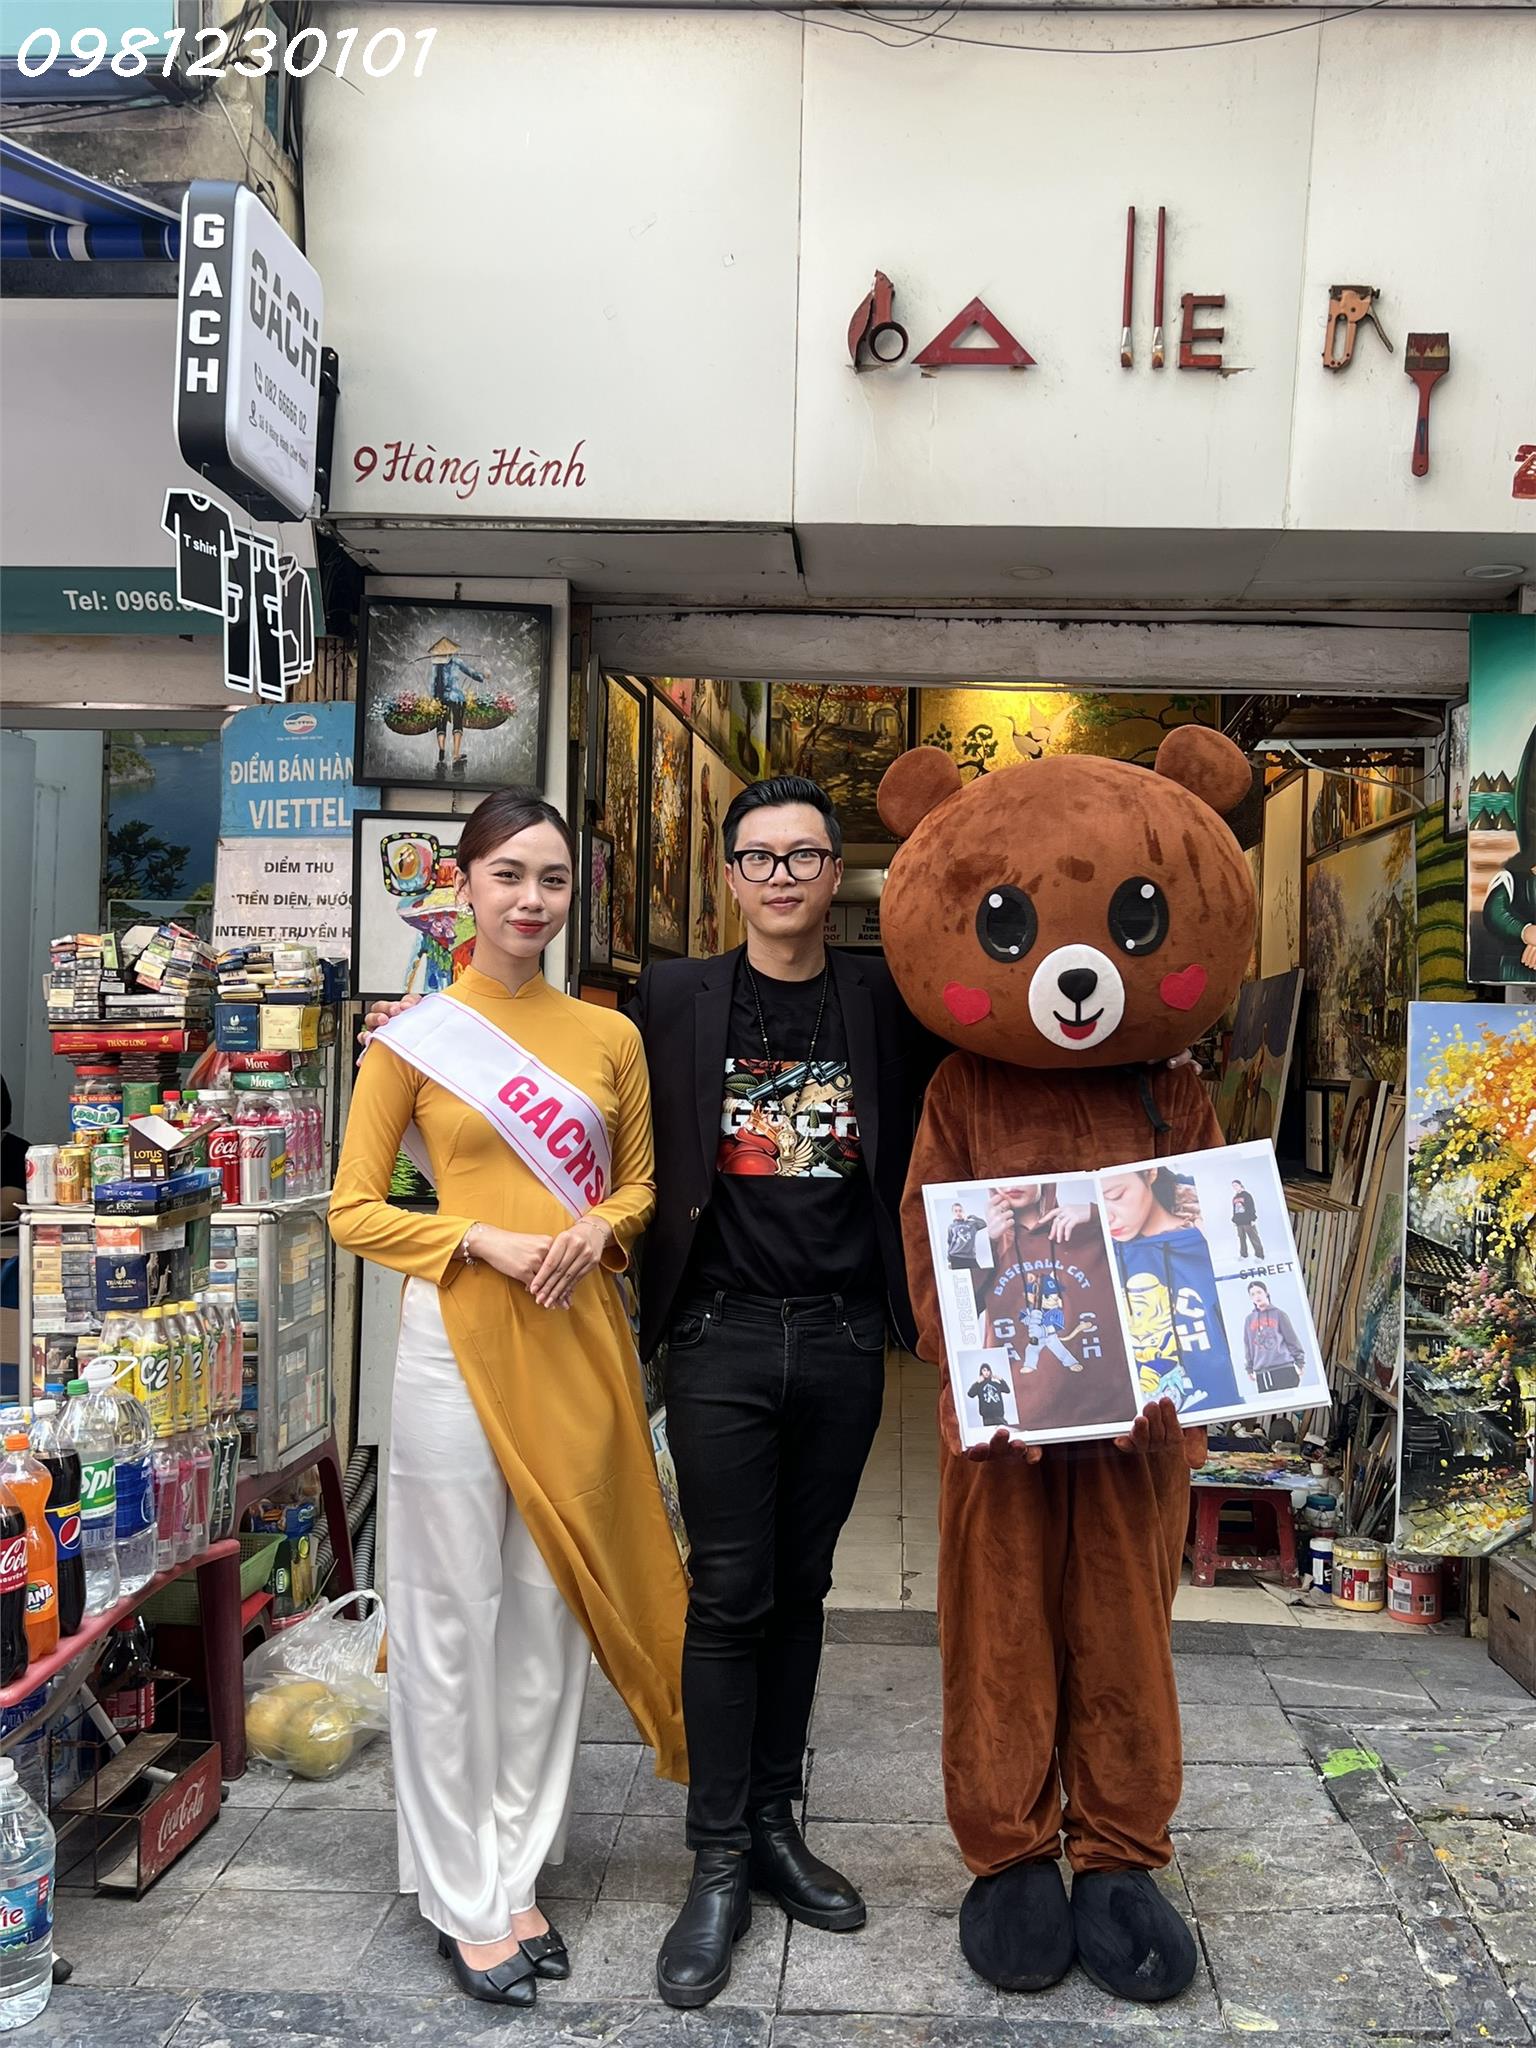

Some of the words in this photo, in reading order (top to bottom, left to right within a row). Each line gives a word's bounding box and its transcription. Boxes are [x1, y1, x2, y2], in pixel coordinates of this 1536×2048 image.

[185, 212, 225, 393] GACH
[249, 248, 319, 388] GACH
[354, 446, 378, 483] 9
[382, 440, 480, 500] Hàng
[487, 439, 587, 487] Hành
[183, 534, 192, 547] T
[193, 538, 218, 558] shirt
[63, 590, 108, 611] Tel:
[230, 752, 274, 785] ĐIỂM
[279, 754, 315, 783] BÁN
[249, 797, 352, 830] VIETTEL
[264, 855, 300, 874] ĐIỂM
[305, 862, 334, 874] THU
[273, 891, 311, 909] ĐIỆN,
[215, 925, 276, 938] INTENET
[280, 921, 337, 939] TRUYỀN
[245, 1057, 270, 1070] More
[250, 1075, 274, 1088] More
[134, 1150, 162, 1159] LOTUS
[209, 1136, 238, 1159] Coca
[994, 1258, 1064, 1296] BASEBALL
[1066, 1265, 1091, 1289] CAT
[1239, 1262, 1294, 1280] STREET
[141, 1355, 169, 1390] C2
